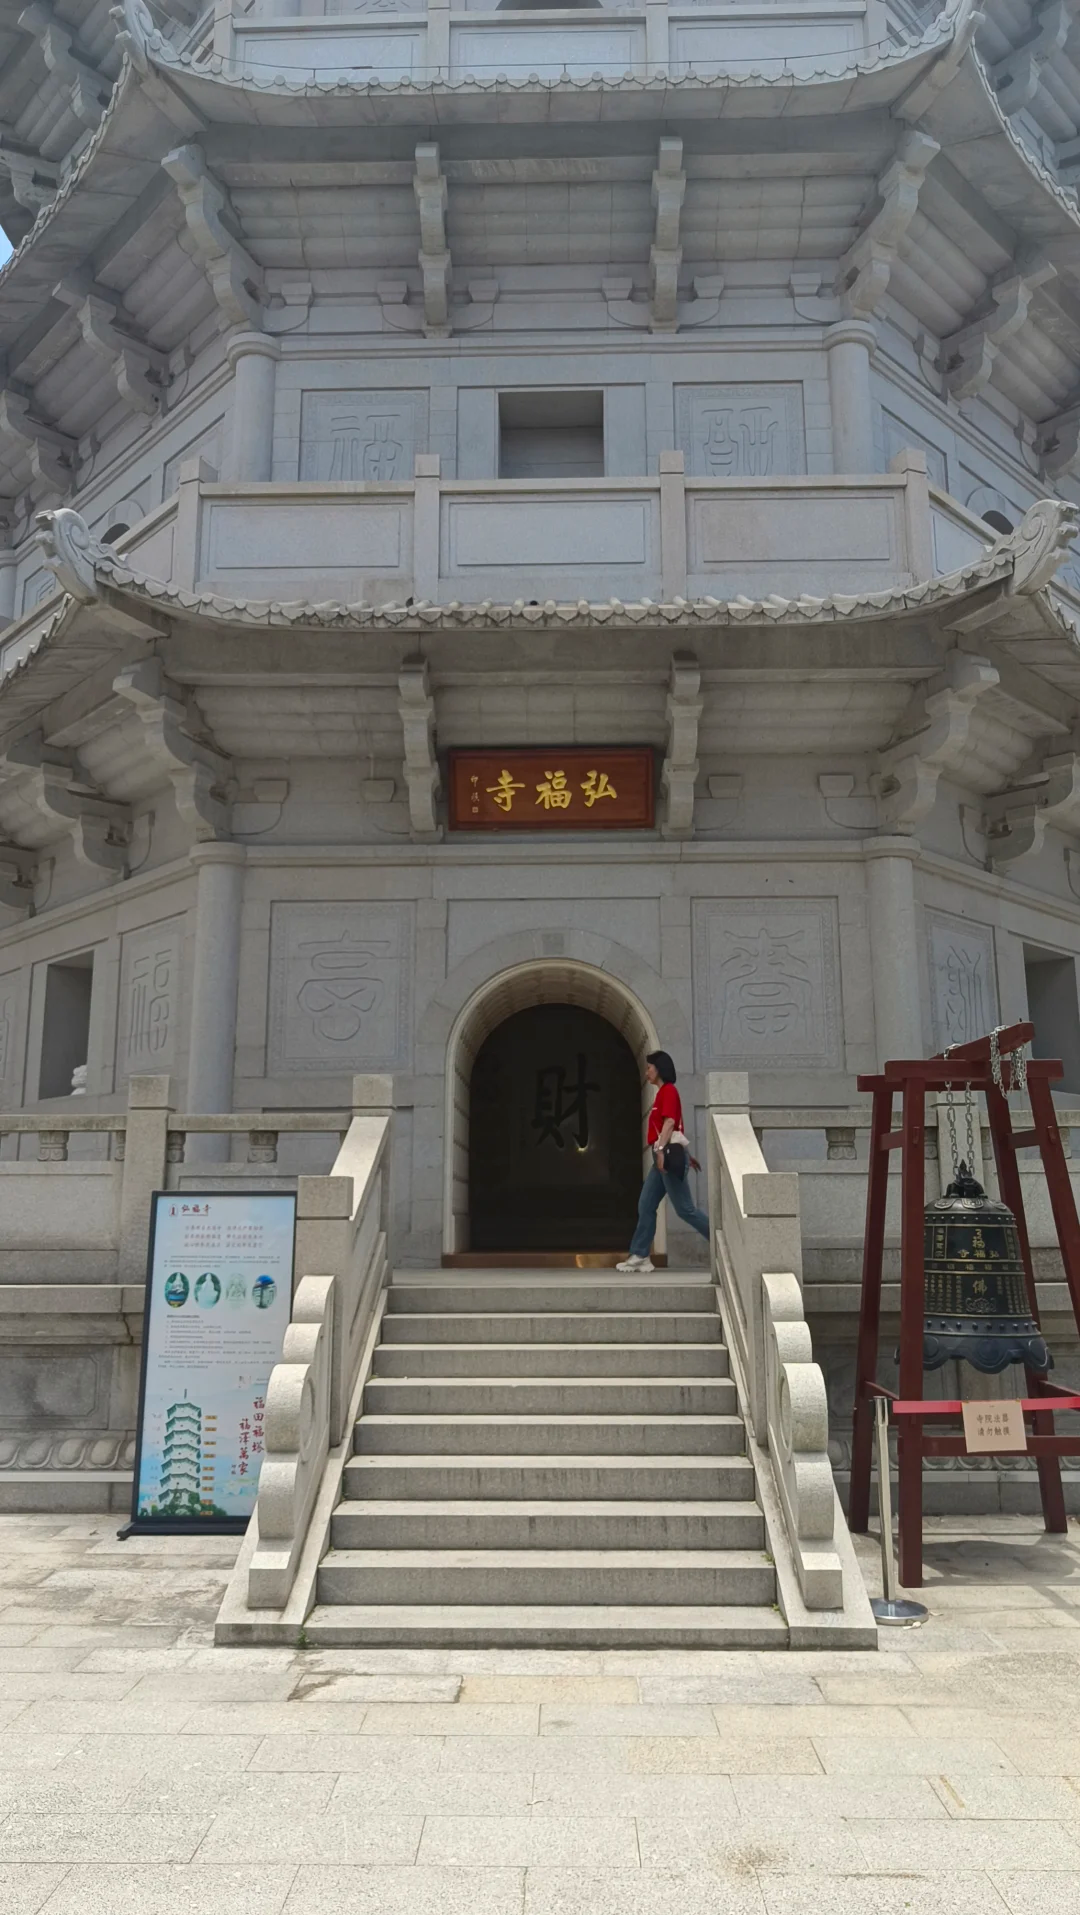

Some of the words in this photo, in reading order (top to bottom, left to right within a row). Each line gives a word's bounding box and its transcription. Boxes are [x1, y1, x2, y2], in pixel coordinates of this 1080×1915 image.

[486, 769, 618, 812] 弘福寺
[531, 1052, 601, 1149] 財
[973, 1279, 988, 1295] 佛
